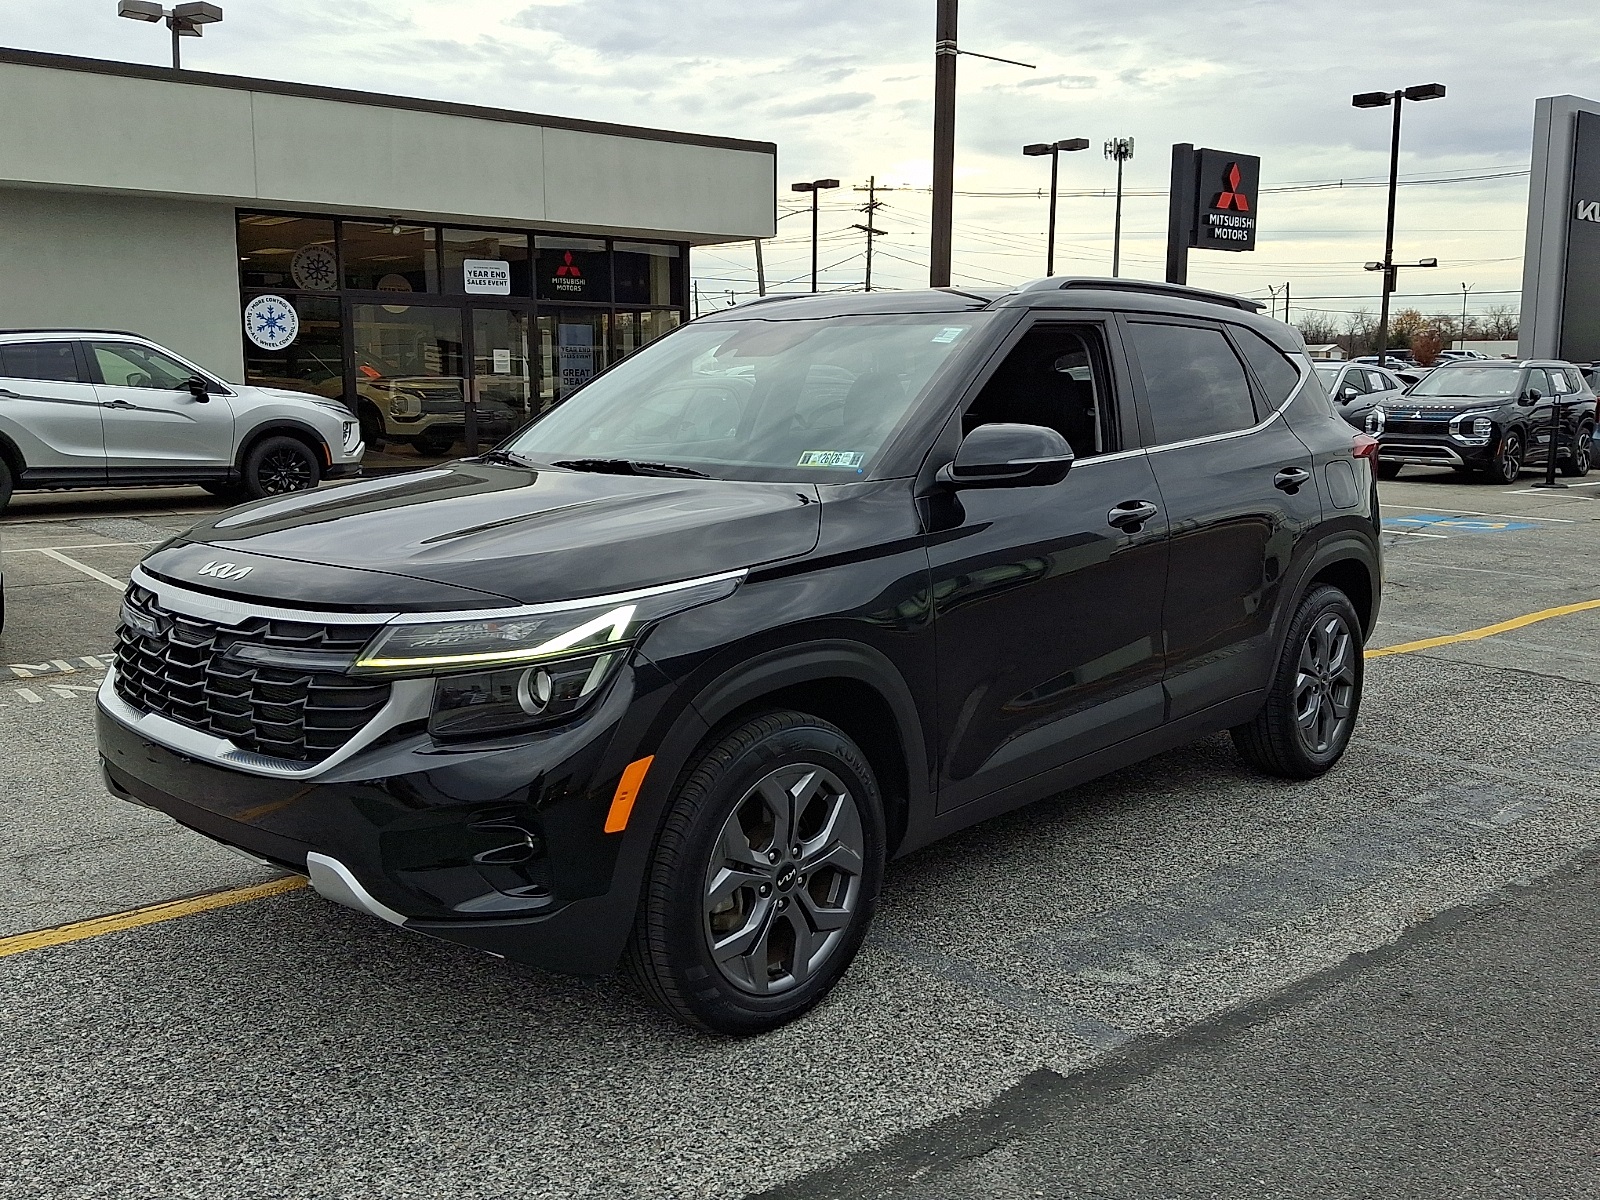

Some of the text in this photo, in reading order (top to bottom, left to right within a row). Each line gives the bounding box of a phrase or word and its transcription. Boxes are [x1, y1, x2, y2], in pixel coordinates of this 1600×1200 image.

[1577, 200, 1600, 222] KI
[1209, 214, 1254, 229] MITSUBISHI
[1214, 228, 1248, 240] MOTORS
[468, 269, 507, 279] YEAR END
[551, 277, 586, 286] MITSUBISHI
[556, 284, 582, 292] MOTORS
[251, 297, 296, 323] MORE CONTROL WITH
[260, 339, 279, 347] WHEEL
[279, 325, 296, 346] CONTROL
[562, 368, 591, 377] GREAT
[199, 561, 253, 581] KIA
